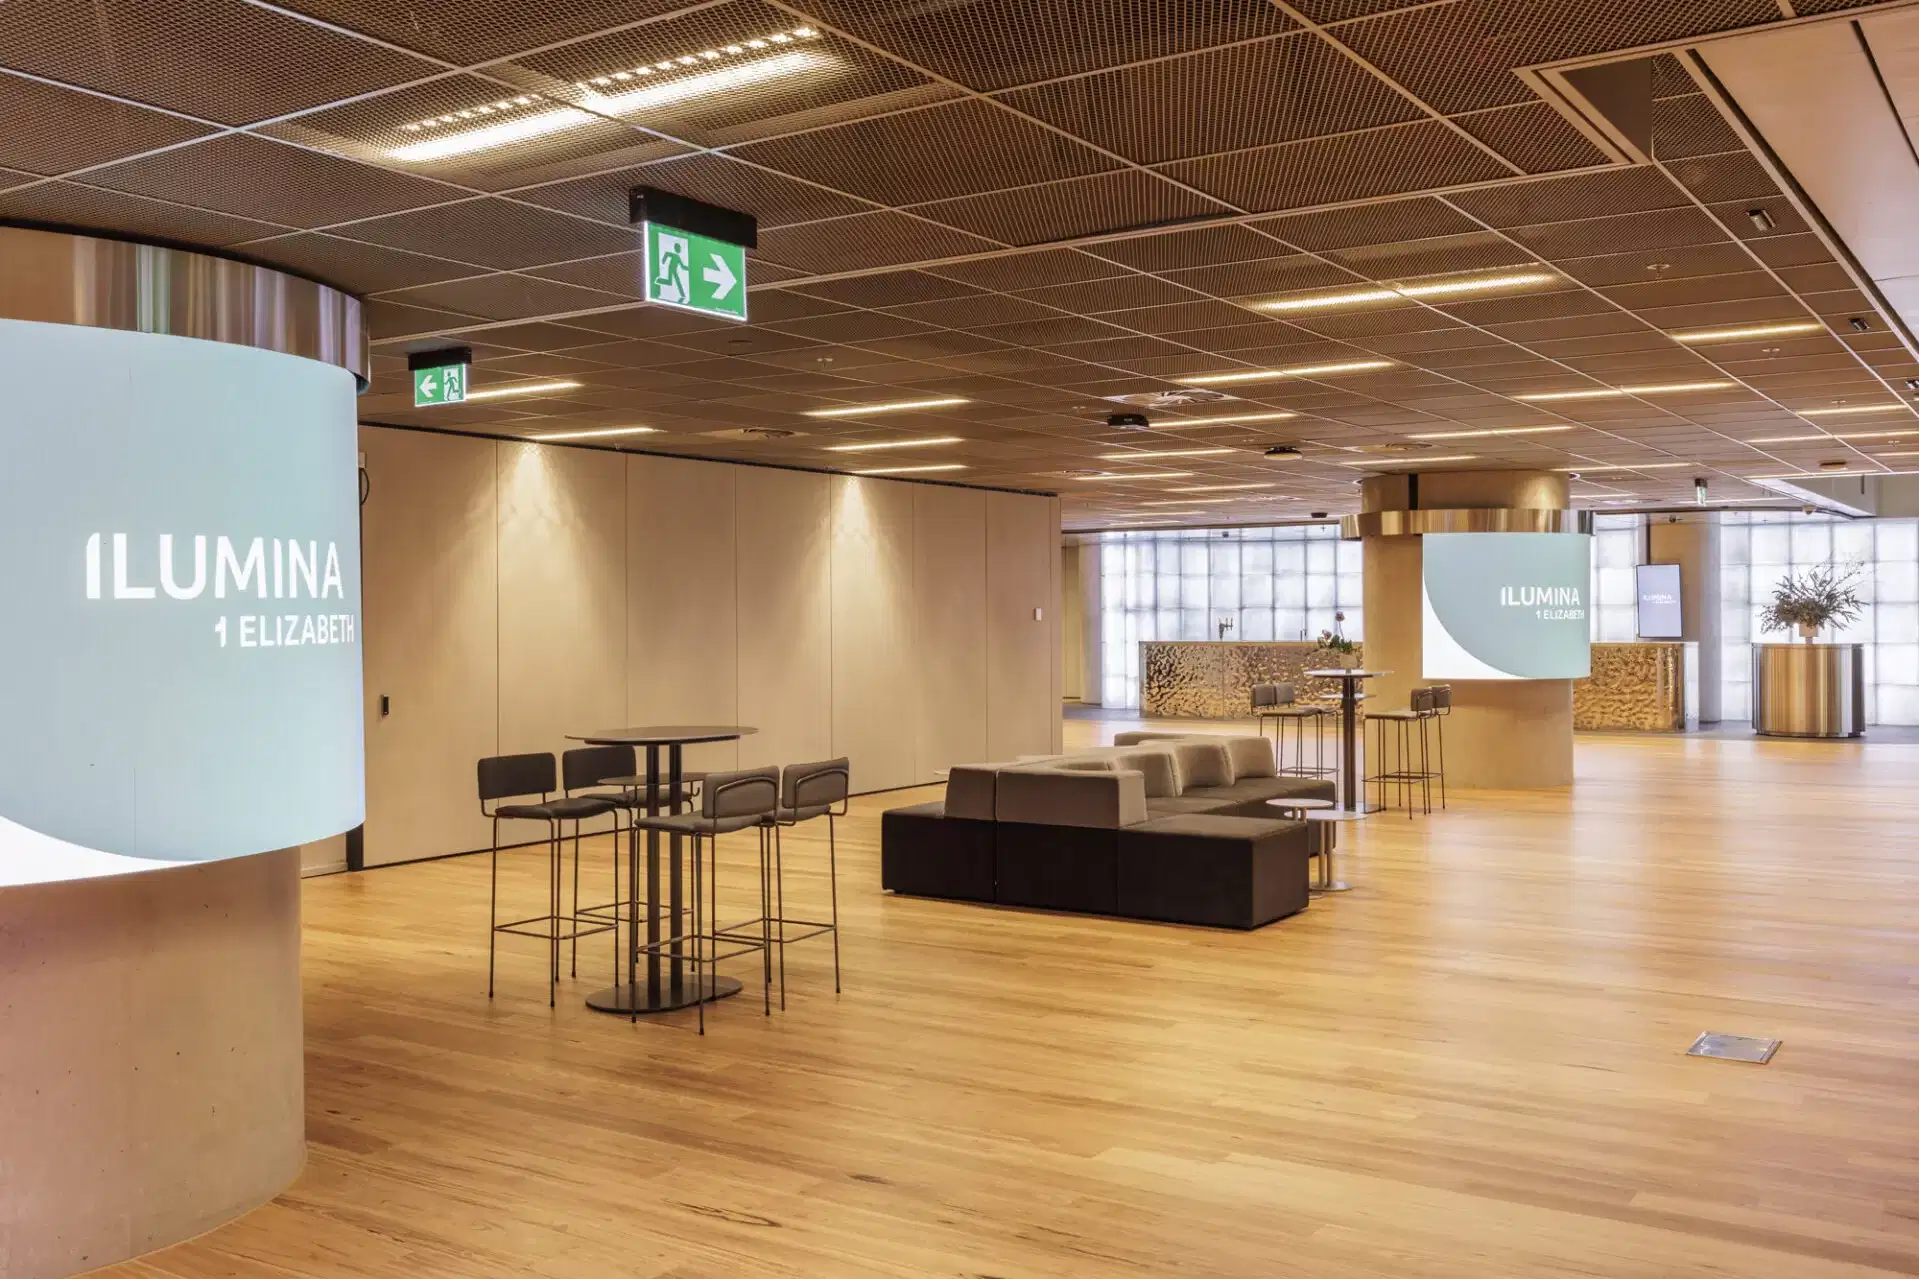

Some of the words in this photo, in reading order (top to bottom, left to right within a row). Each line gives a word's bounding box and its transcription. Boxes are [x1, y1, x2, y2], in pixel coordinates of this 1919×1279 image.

[86, 532, 344, 600] ILUMINA
[1501, 586, 1580, 606] ILUMINA
[214, 615, 228, 648] 1
[239, 613, 355, 648] ELIZABETH
